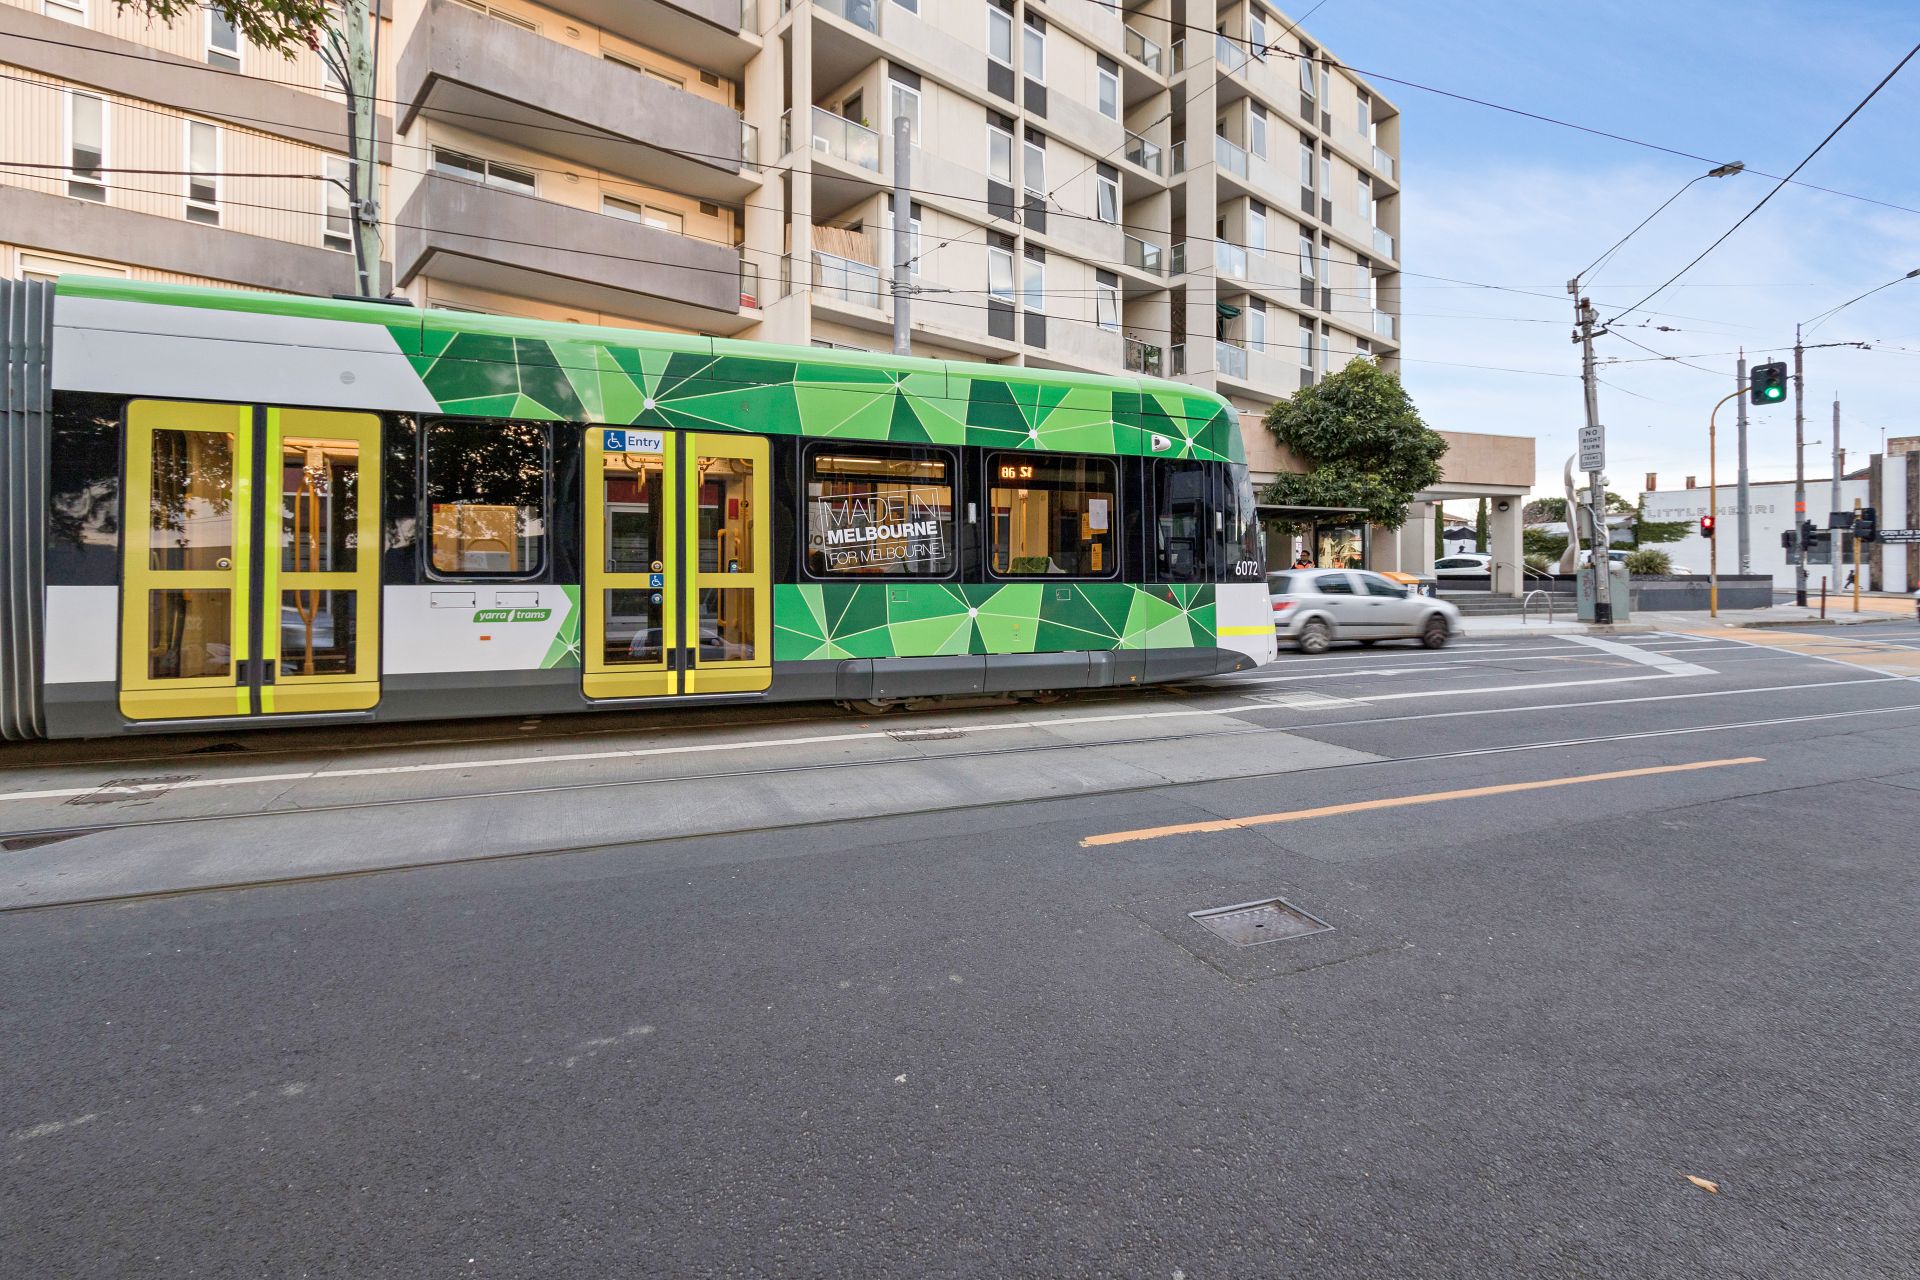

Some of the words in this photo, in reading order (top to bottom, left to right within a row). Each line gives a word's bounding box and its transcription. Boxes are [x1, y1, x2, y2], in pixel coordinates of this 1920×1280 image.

[628, 435, 660, 450] Entry
[1001, 466, 1016, 479] 86
[823, 496, 908, 527] MADE
[912, 493, 937, 520] IN
[1647, 507, 1708, 519] LITTLE
[827, 520, 938, 545] MELBOURNE
[829, 551, 858, 566] FOR
[860, 542, 940, 563] MELBOURNE
[1235, 560, 1258, 576] 6072
[479, 612, 507, 622] yarra
[516, 611, 545, 619] trams
